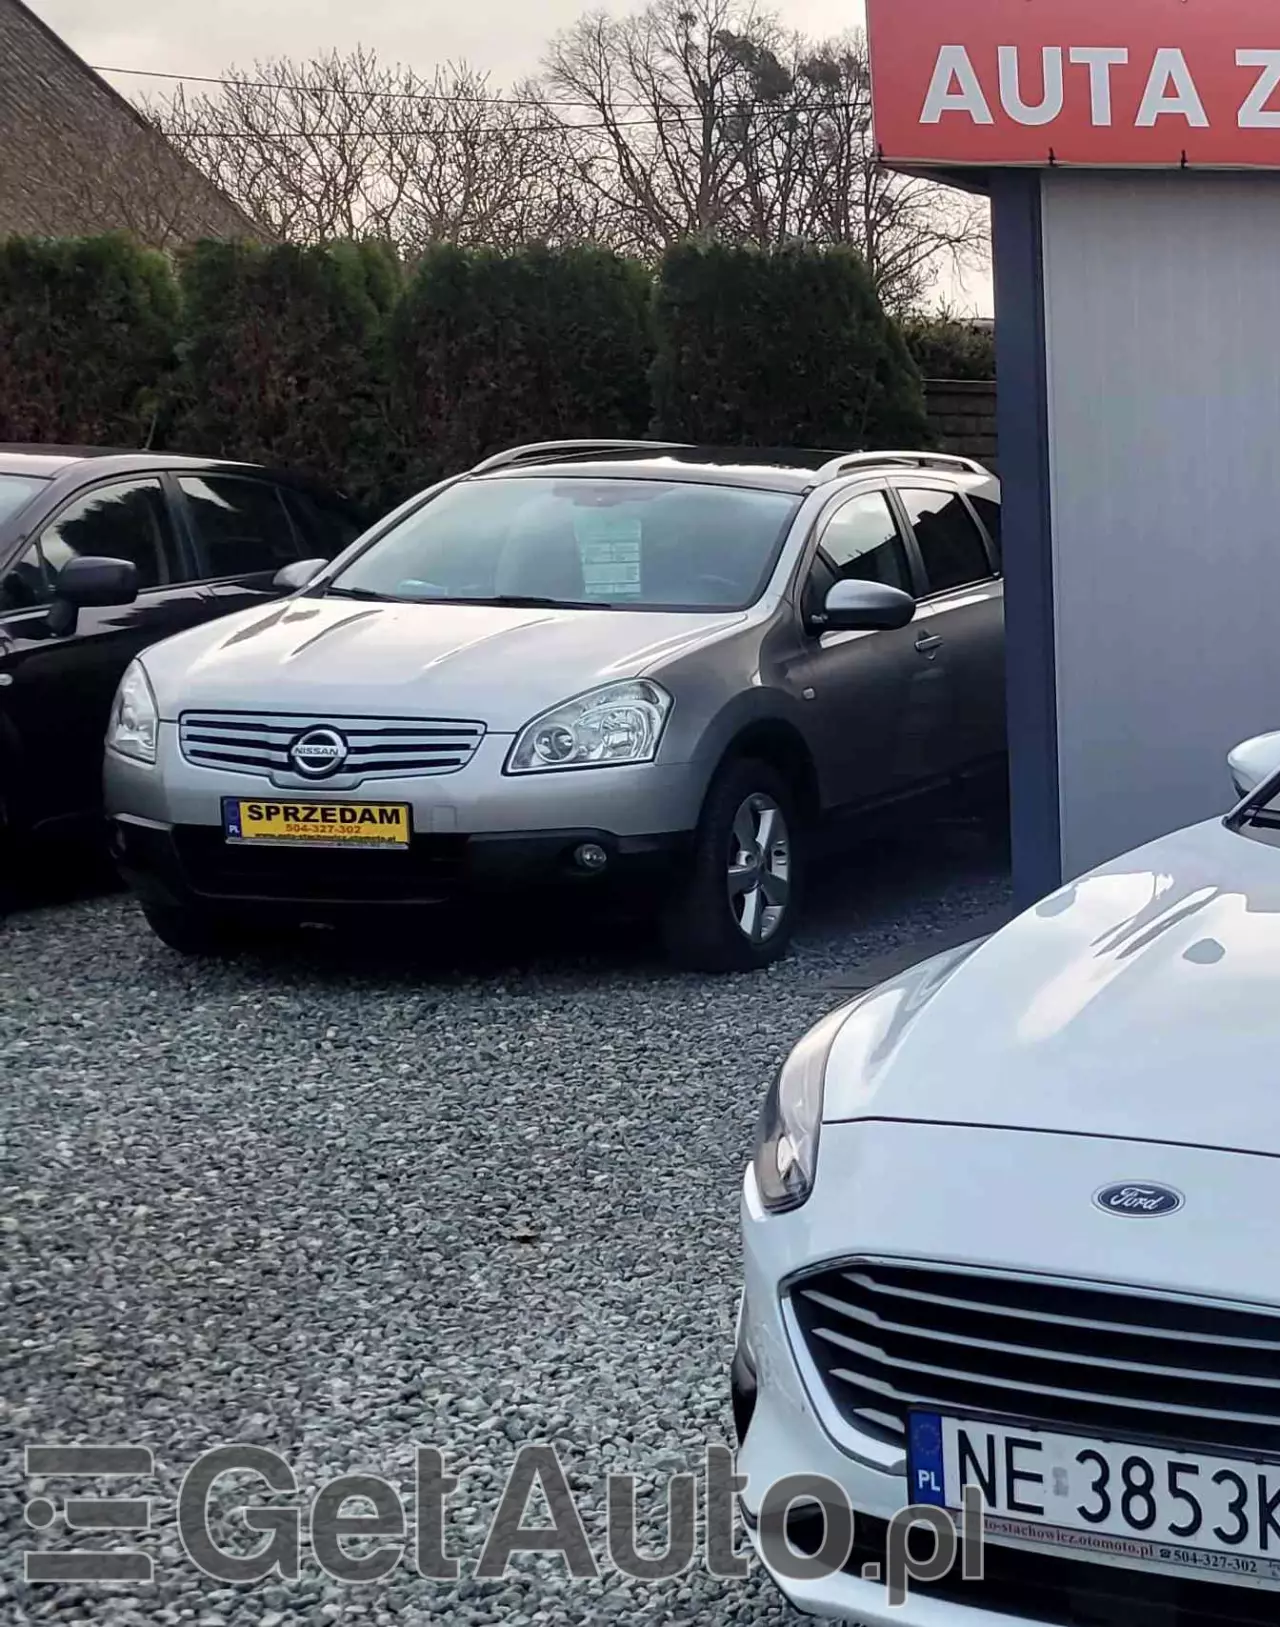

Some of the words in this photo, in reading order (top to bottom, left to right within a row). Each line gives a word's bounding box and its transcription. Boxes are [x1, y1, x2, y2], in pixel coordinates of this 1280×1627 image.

[919, 44, 1209, 127] AUTA
[295, 747, 339, 756] NISSAN
[247, 804, 400, 825] SPRZEDAM
[228, 824, 240, 834] PL
[285, 823, 361, 834] 504-327-302
[1110, 1187, 1165, 1210] Ford
[918, 1468, 940, 1492] PL
[957, 1428, 1044, 1516] NE
[1173, 1549, 1257, 1574] 504-327-302
